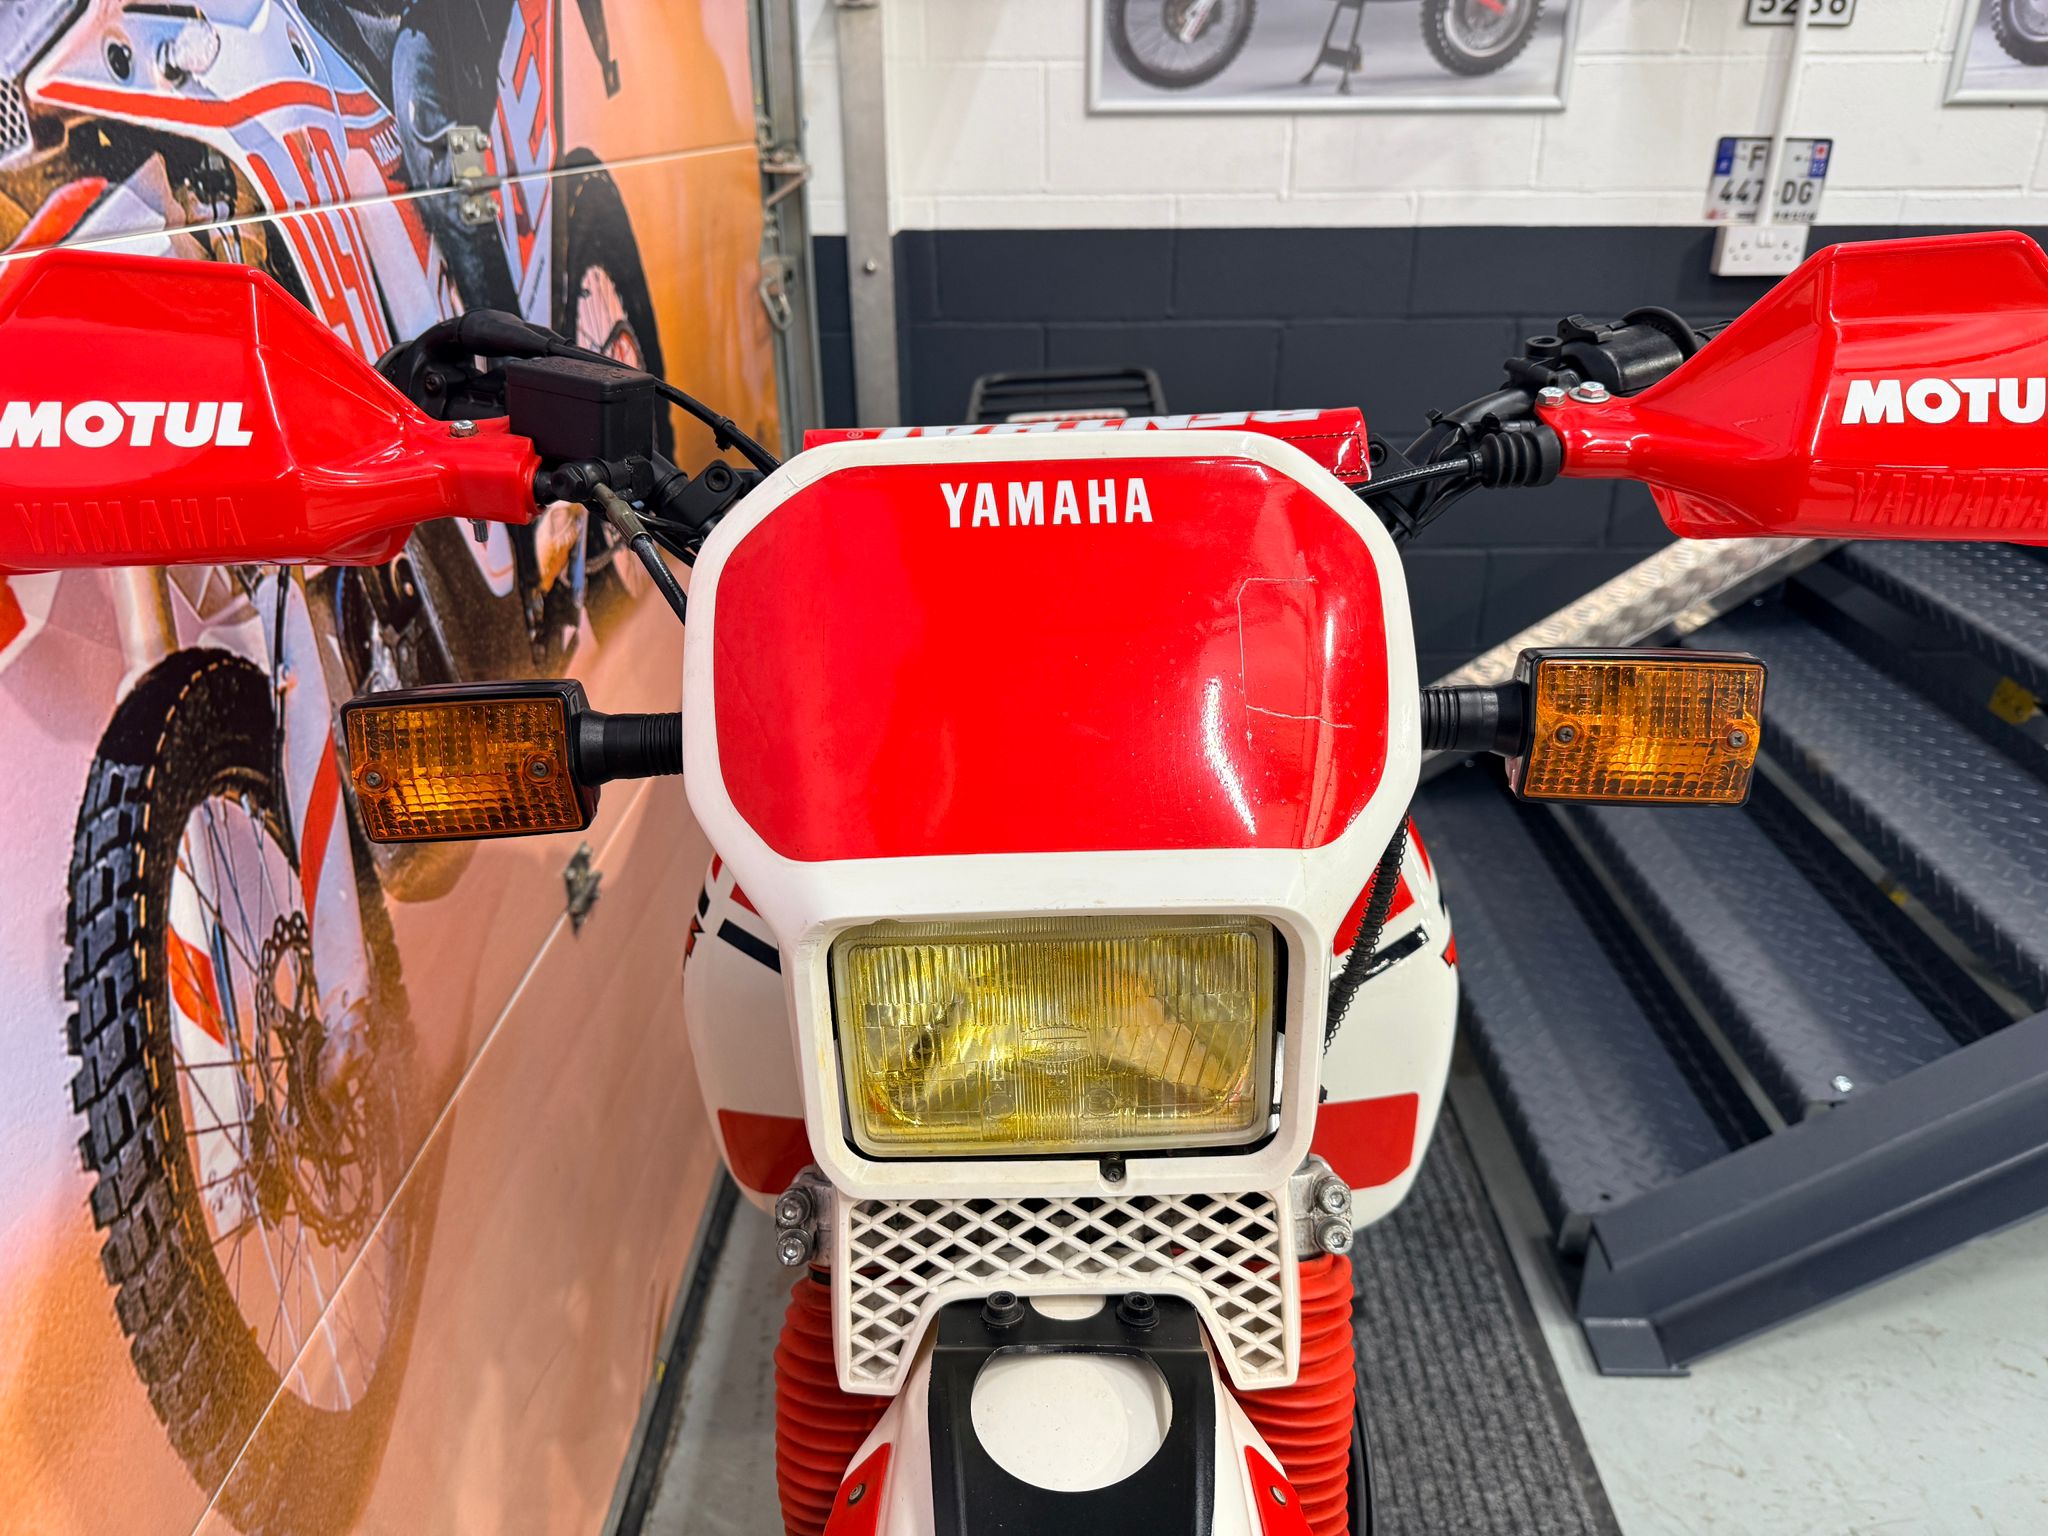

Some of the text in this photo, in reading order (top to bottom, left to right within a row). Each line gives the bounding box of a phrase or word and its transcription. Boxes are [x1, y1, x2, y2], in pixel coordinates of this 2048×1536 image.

[1781, 180, 1813, 205] DG
[0, 400, 253, 448] MOTUL
[1841, 377, 2046, 424] MOTU
[14, 496, 247, 554] YAMAHA
[940, 477, 1154, 528] YAMAHA
